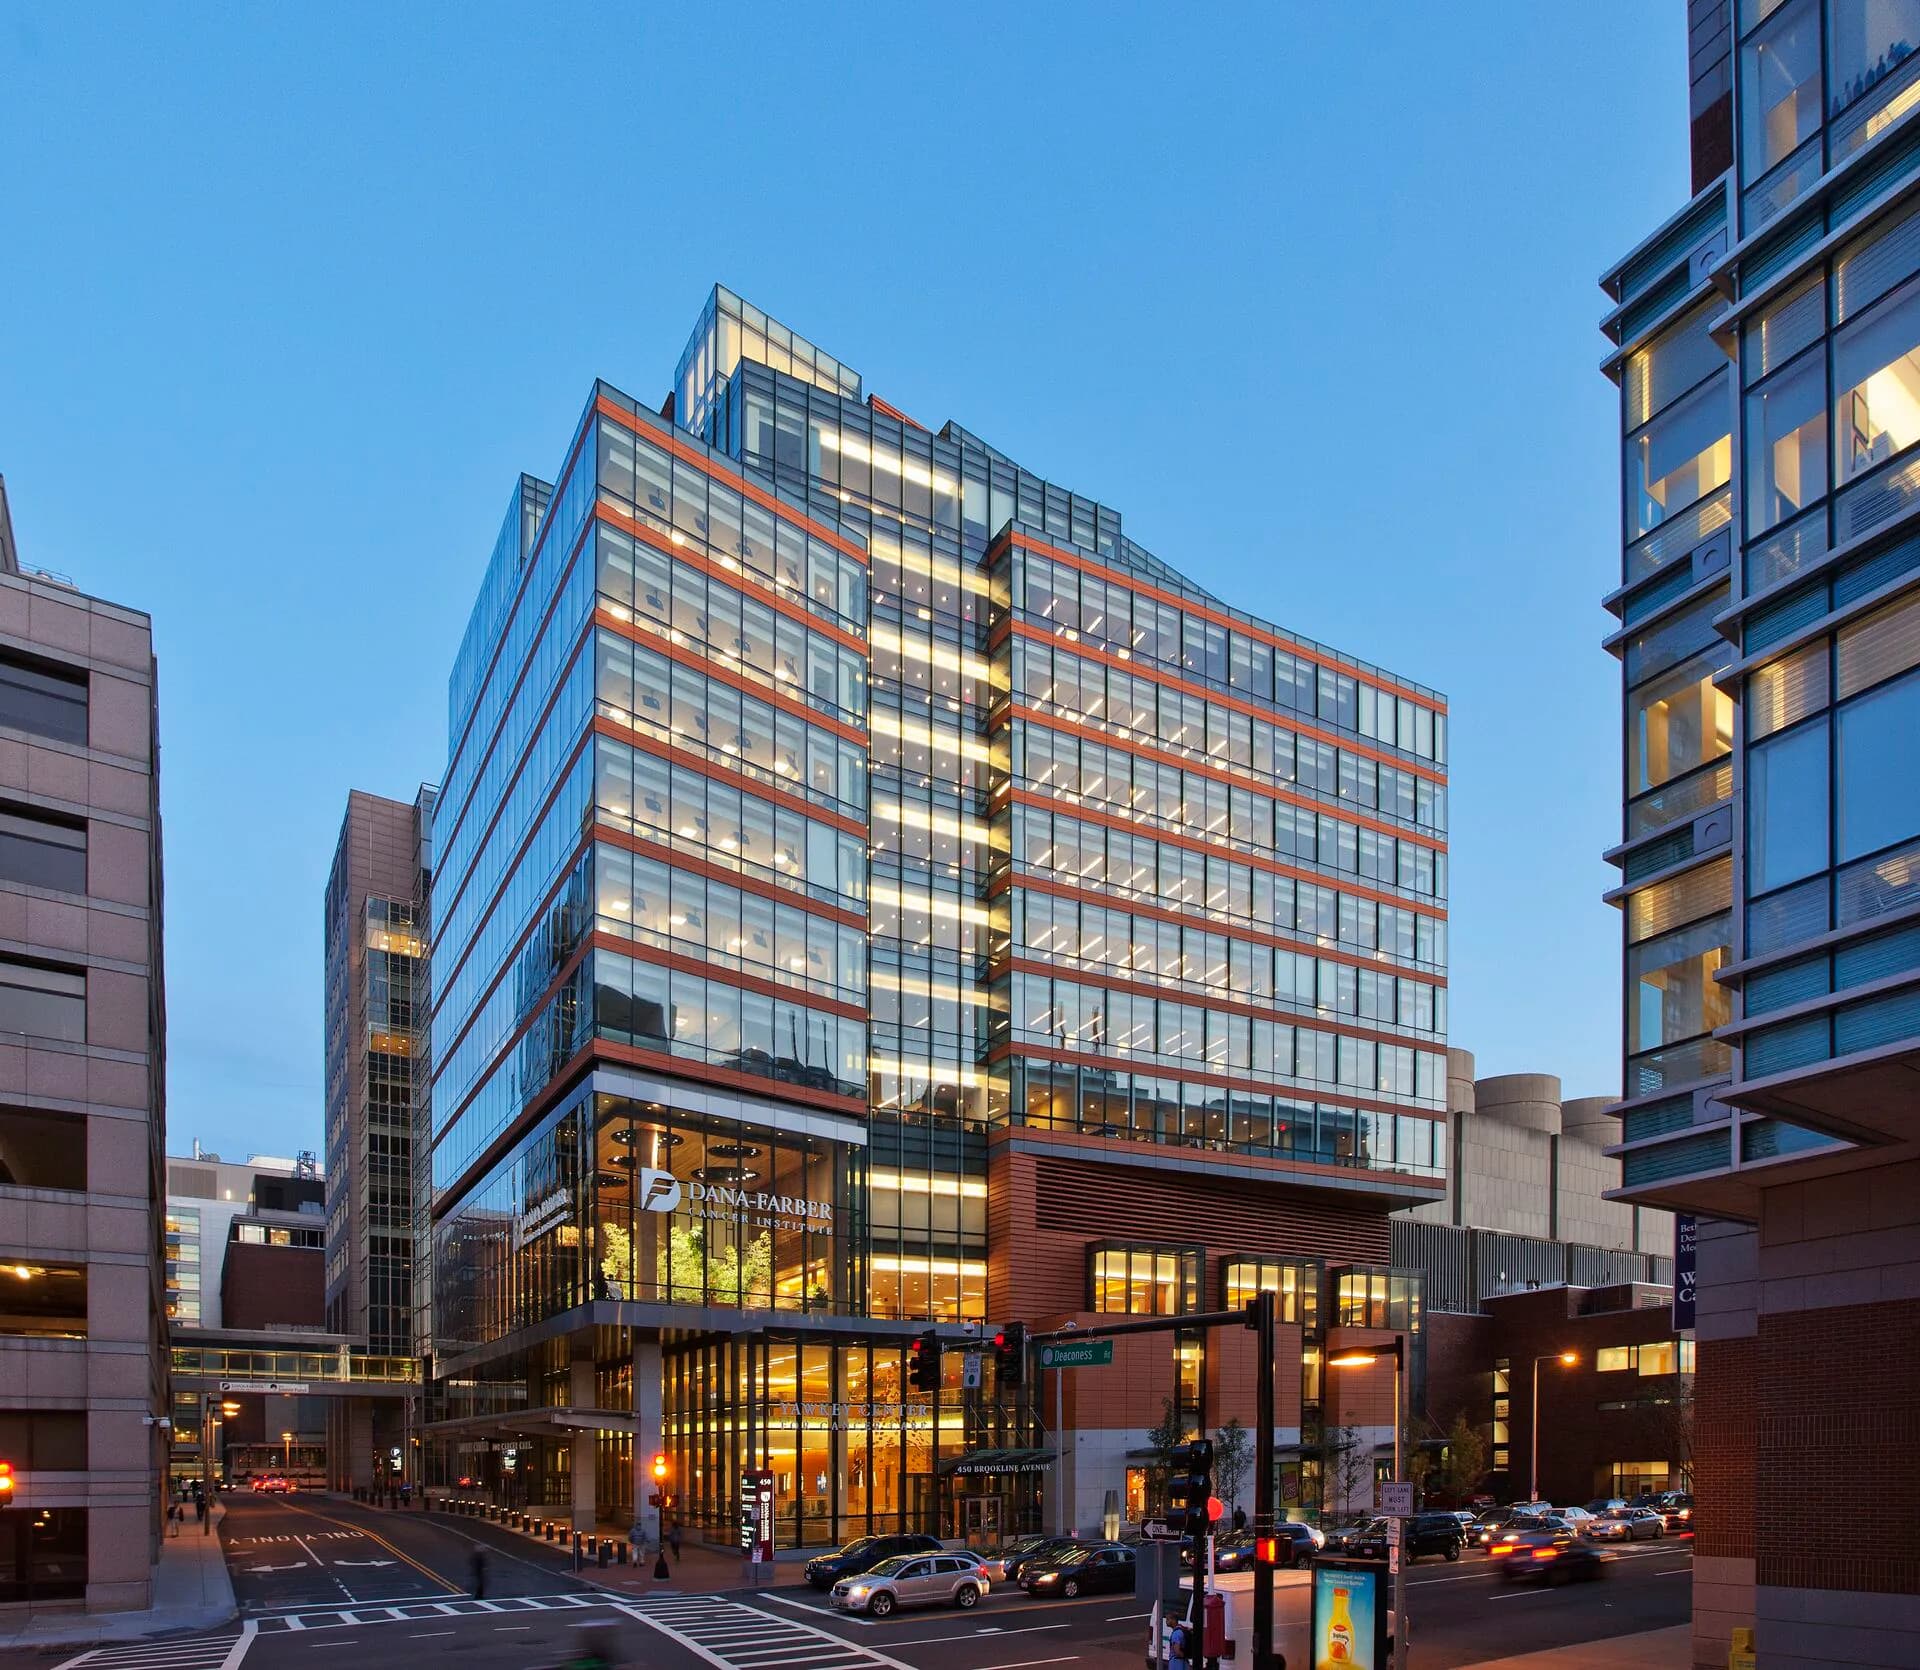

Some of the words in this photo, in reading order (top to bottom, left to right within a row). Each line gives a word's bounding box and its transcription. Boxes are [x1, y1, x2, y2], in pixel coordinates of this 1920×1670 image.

[688, 1182, 832, 1220] DANA-FARBER
[688, 1207, 748, 1224] CANCER
[756, 1216, 833, 1236] INSTITUTE
[1054, 1350, 1093, 1361] Deaconess
[780, 1402, 850, 1416] YAWKEY
[858, 1404, 928, 1417] CENTER
[974, 1465, 1019, 1473] BROOKLINE
[1021, 1464, 1051, 1472] AVENUE
[229, 1535, 290, 1545] ONLY
[305, 1531, 364, 1541] ONLY
